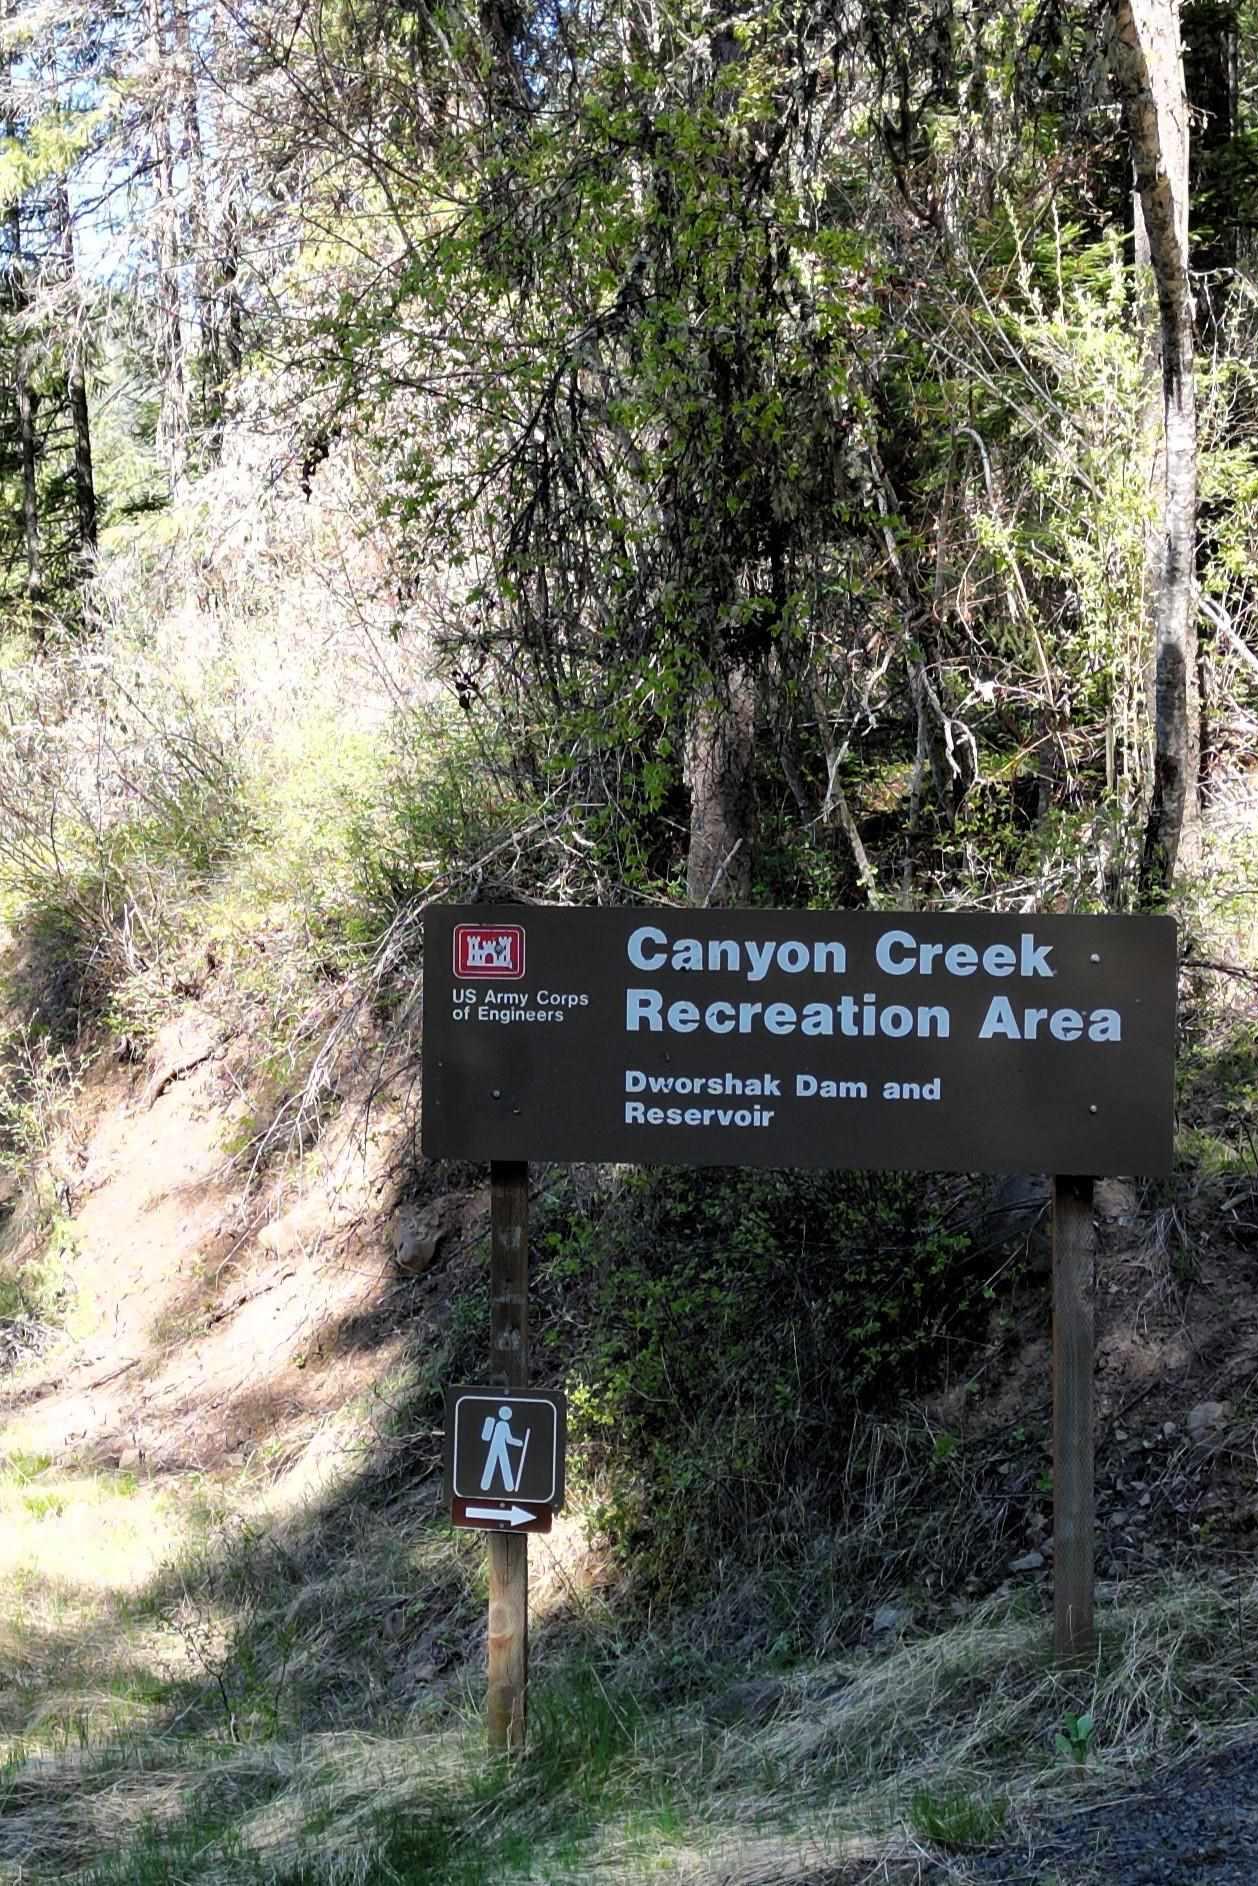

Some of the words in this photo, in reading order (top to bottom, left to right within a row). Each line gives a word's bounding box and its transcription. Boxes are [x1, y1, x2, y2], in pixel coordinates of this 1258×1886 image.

[627, 926, 847, 981] Canyon
[875, 930, 1054, 977] Creek
[452, 988, 477, 1004] US
[485, 990, 528, 1007] Army
[536, 990, 589, 1008] Corps
[452, 1006, 469, 1021] of
[478, 1006, 564, 1024] Engineers
[625, 988, 950, 1038] Recreation
[978, 996, 1122, 1042] Area
[624, 1071, 781, 1096] Dworshak
[796, 1074, 867, 1099] Dam
[882, 1078, 941, 1101] and
[624, 1102, 774, 1128] Reservoir
